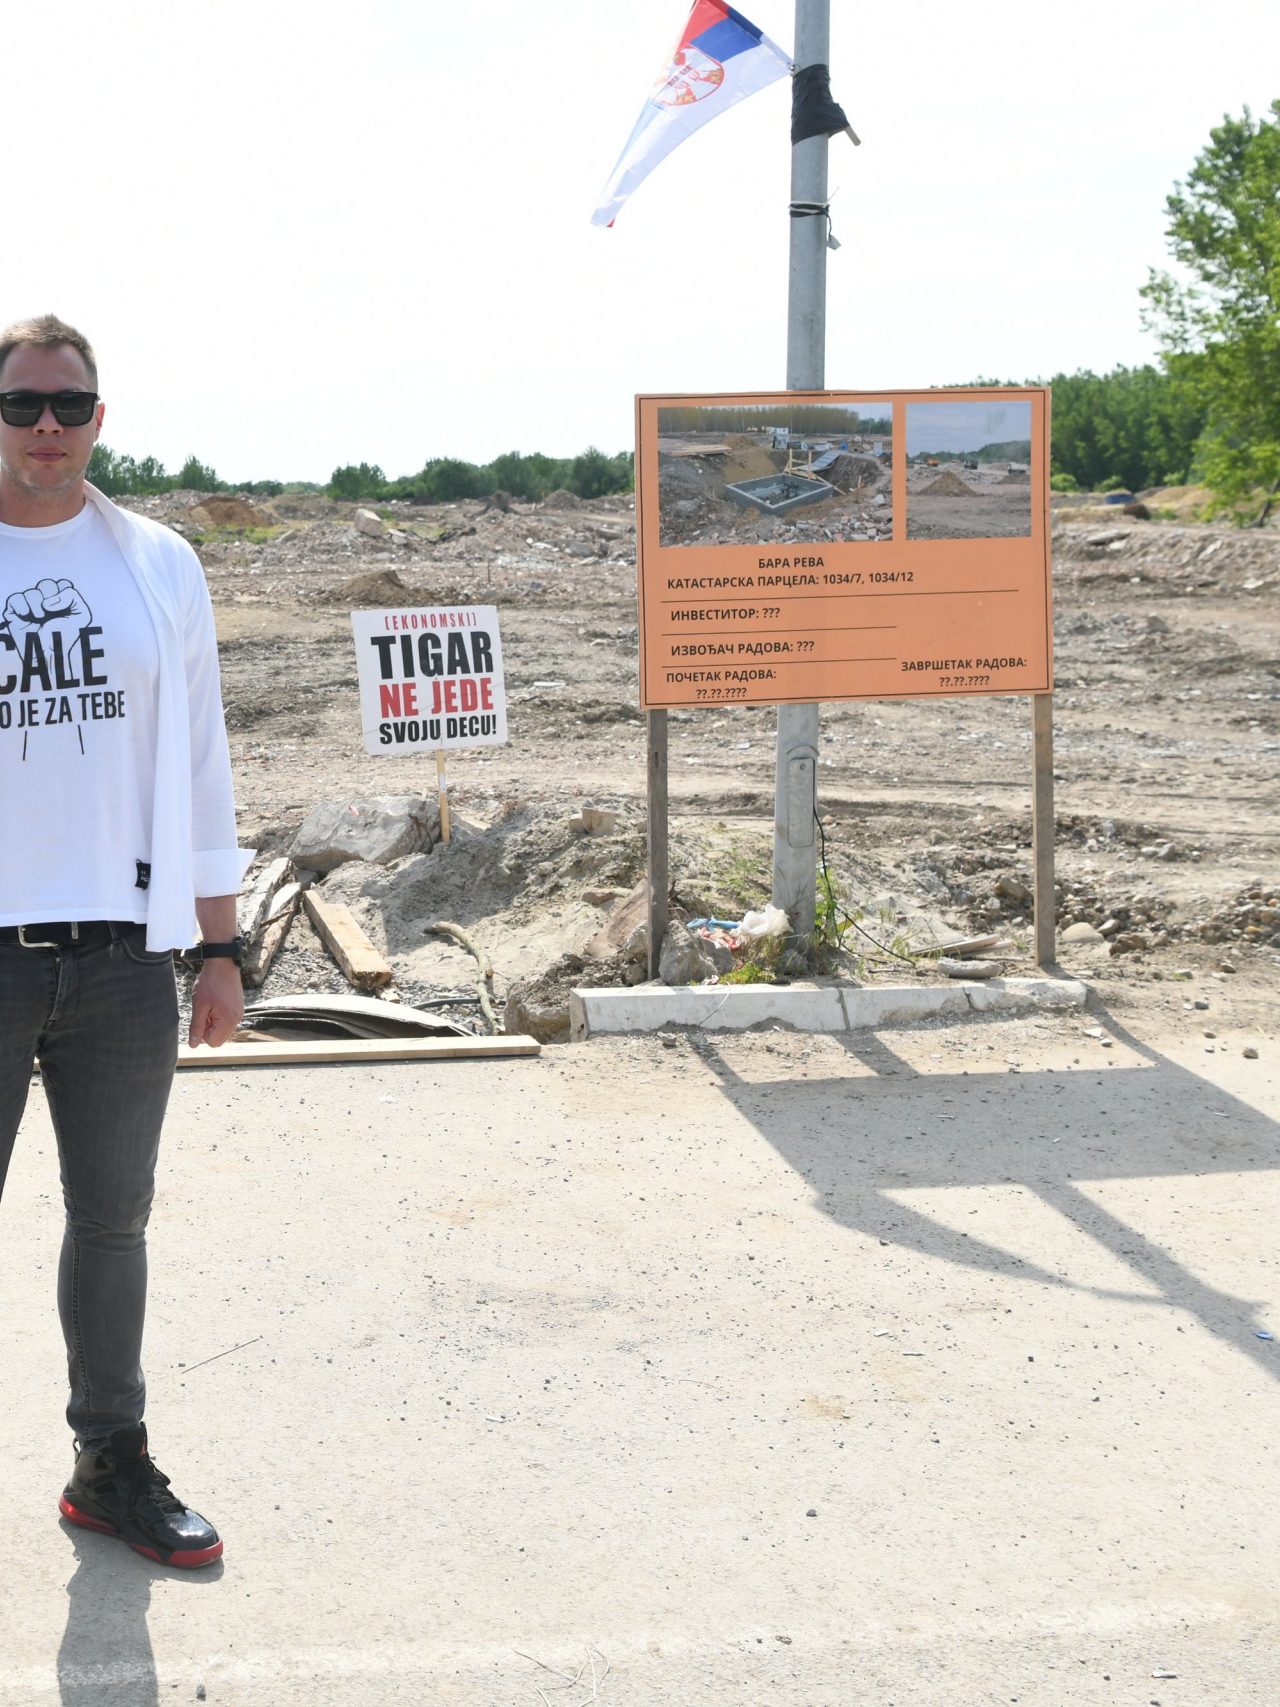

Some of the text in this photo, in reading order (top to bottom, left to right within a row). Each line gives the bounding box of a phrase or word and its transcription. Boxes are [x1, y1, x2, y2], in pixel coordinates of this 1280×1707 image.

[758, 556, 824, 569] БАРА РЕВА
[667, 571, 914, 589] КАТАСТАРСКА ПАРЦЕЛА: 1034/7, 1034/12
[671, 607, 781, 621] ИНВЕСТИТОР: ???
[371, 631, 494, 680] TIGAR
[671, 640, 815, 656] ИЗВОЂАЧ РАДОВА: ???
[901, 657, 1027, 672] ЗАВРШЕТАК РАДОВА:
[666, 669, 776, 684] ПОЧЕТАК РАДОВА:
[379, 678, 494, 719] NE JEDE
[18, 699, 39, 727] JE
[45, 696, 73, 724] ZA
[77, 691, 125, 720] TEBE
[379, 715, 497, 745] SVOJU DECU!
